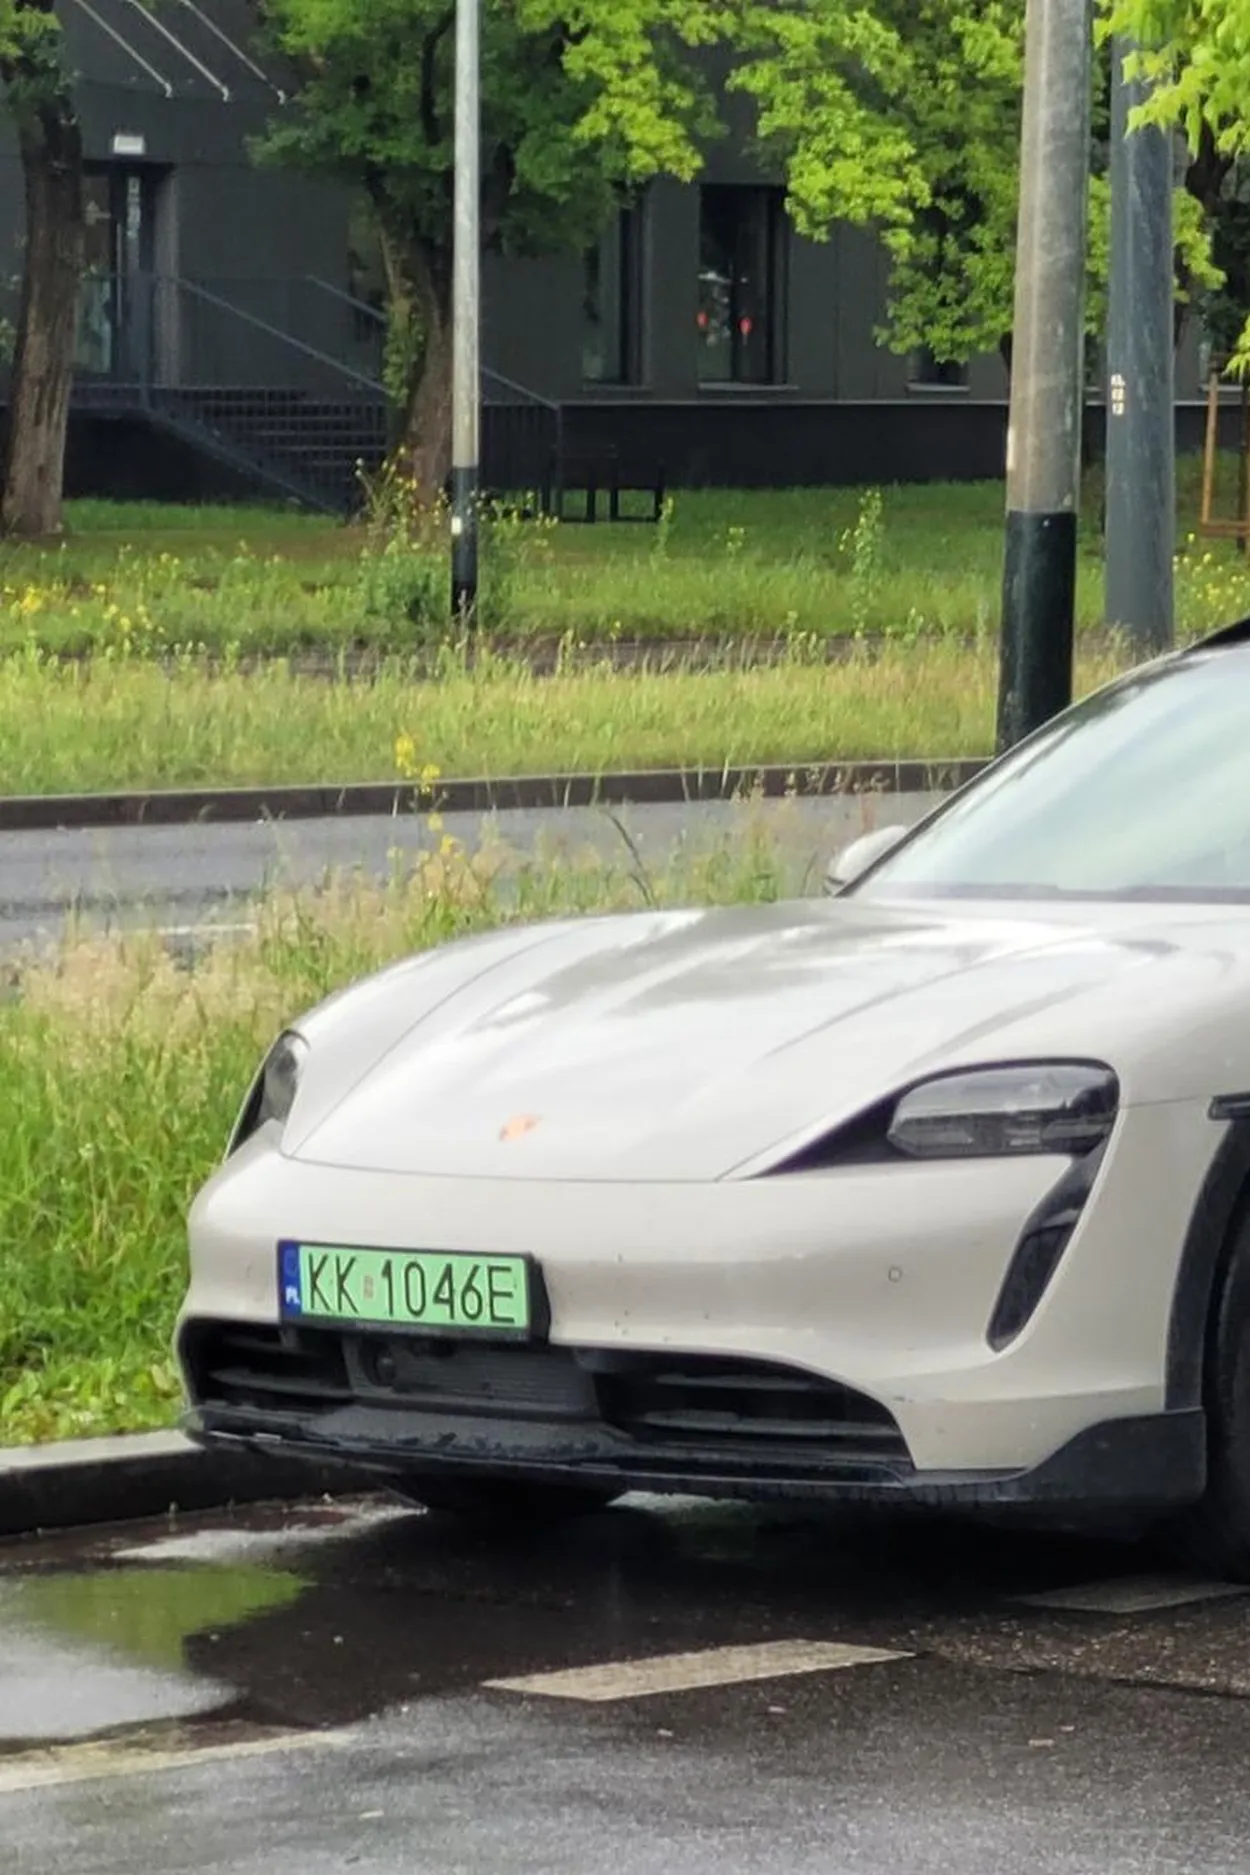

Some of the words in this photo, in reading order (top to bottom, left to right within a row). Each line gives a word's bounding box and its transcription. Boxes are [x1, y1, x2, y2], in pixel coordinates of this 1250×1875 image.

[285, 1286, 300, 1304] PL
[308, 1254, 358, 1313] KK
[381, 1259, 515, 1323] 1046E
